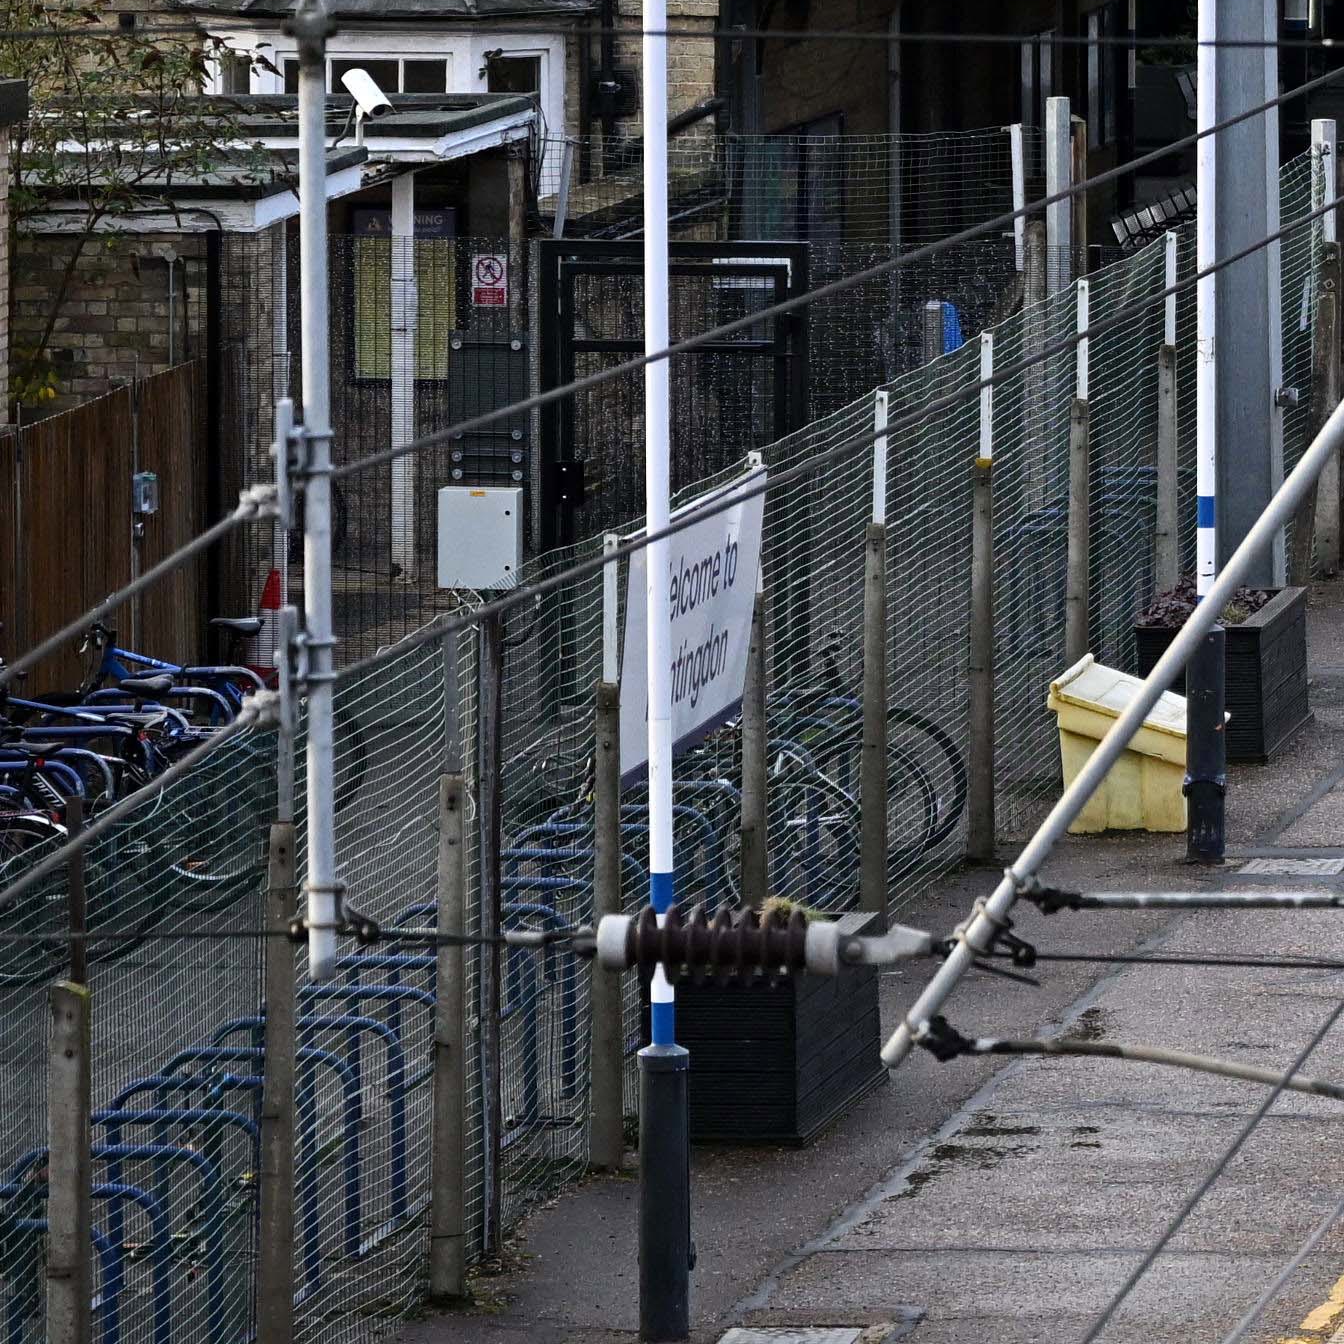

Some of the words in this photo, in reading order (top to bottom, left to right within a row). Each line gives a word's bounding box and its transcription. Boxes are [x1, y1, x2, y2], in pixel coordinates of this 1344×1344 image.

[669, 550, 721, 623] elcome
[723, 533, 738, 590] to
[669, 623, 729, 708] ntingdon
